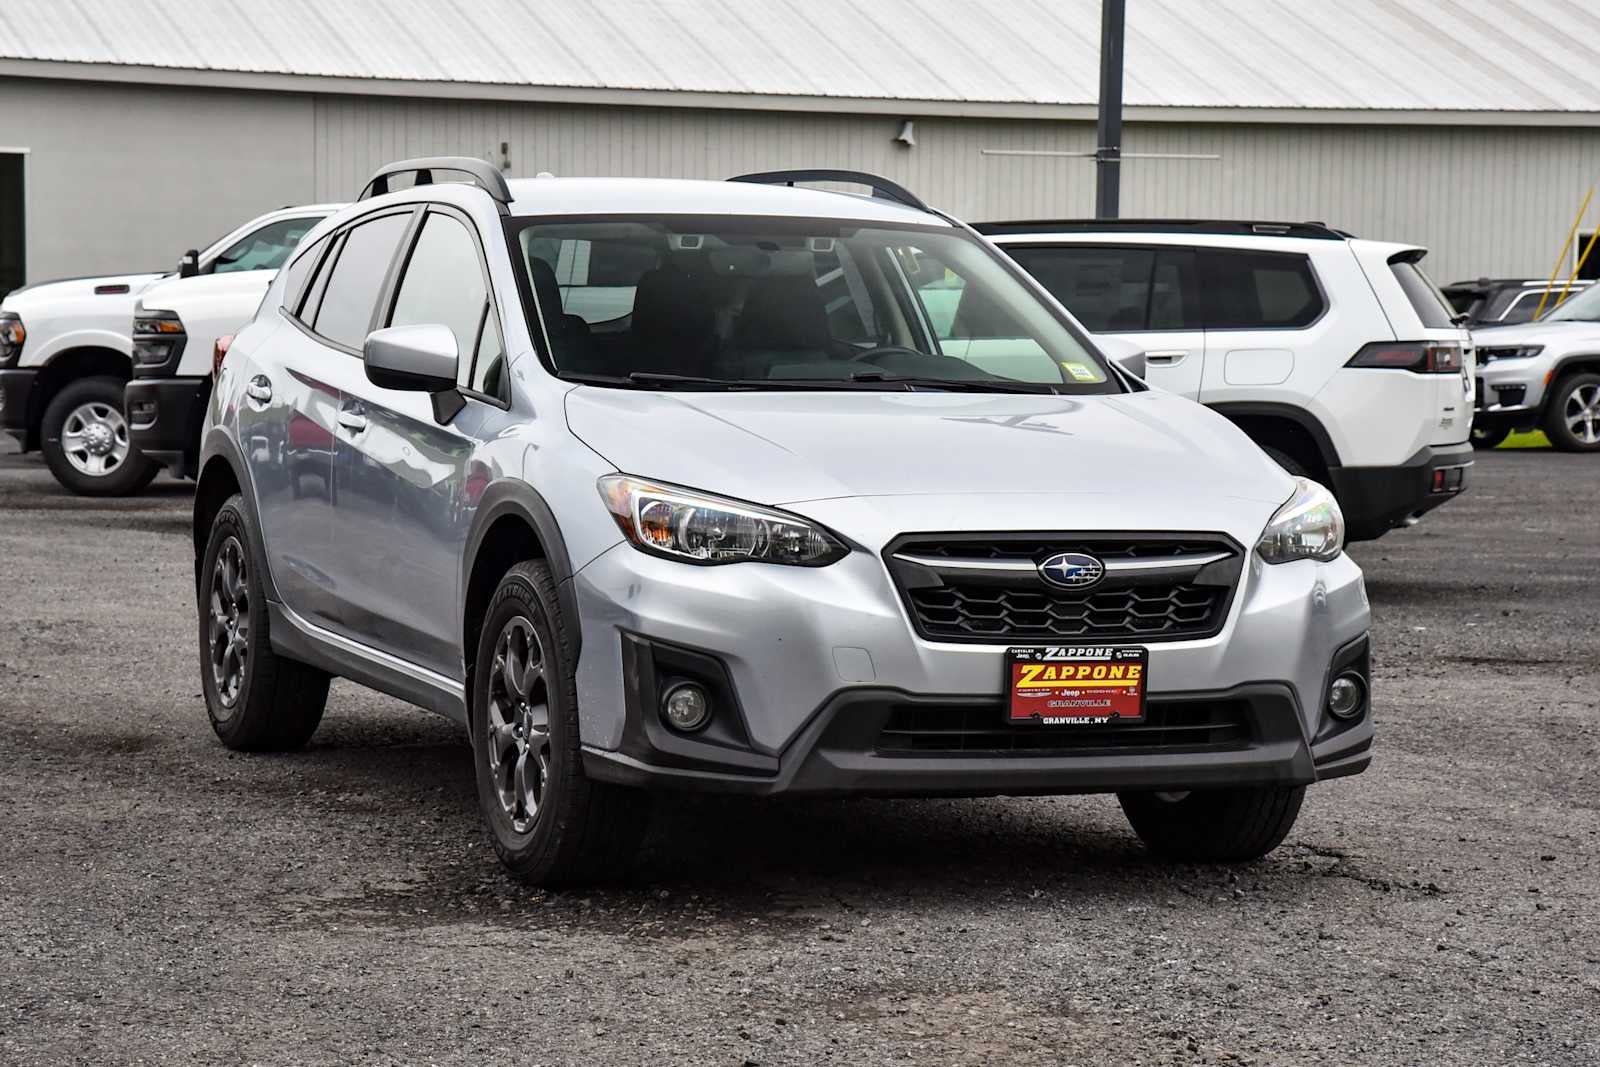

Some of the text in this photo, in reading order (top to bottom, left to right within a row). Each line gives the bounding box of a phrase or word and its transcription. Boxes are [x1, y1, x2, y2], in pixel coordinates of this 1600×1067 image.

[1042, 647, 1113, 661] ZAPPONE
[1016, 664, 1142, 688] ZAPPONE
[1061, 689, 1080, 697] Jeep
[1047, 699, 1111, 708] GRANVILLE
[1096, 716, 1109, 724] NY
